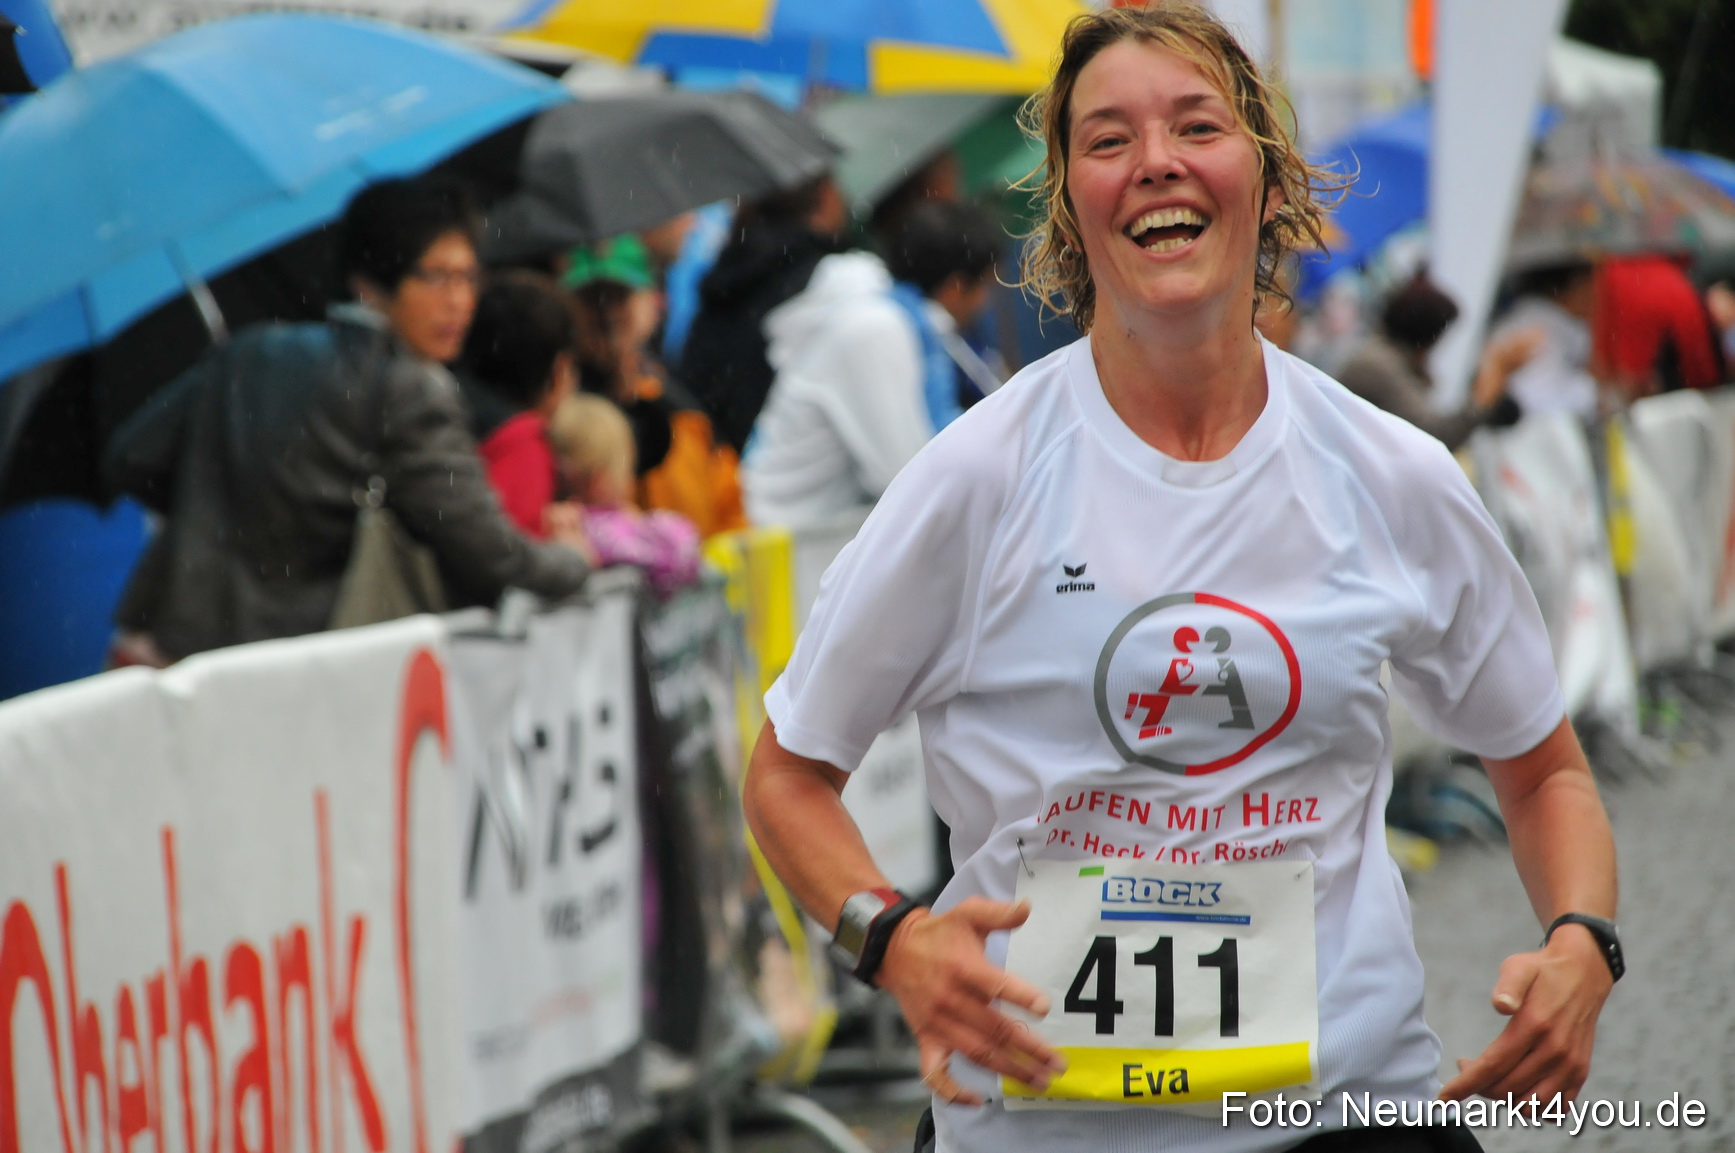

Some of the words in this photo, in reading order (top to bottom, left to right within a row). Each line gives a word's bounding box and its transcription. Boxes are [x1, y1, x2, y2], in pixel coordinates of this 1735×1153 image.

[1056, 581, 1096, 594] erima
[1037, 790, 1151, 825] AUFEN
[1167, 804, 1226, 832] MIT
[1242, 792, 1322, 827] HERZ
[1102, 876, 1223, 907] BOCK
[1064, 935, 1240, 1038] 411
[1122, 1063, 1190, 1099] Eva
